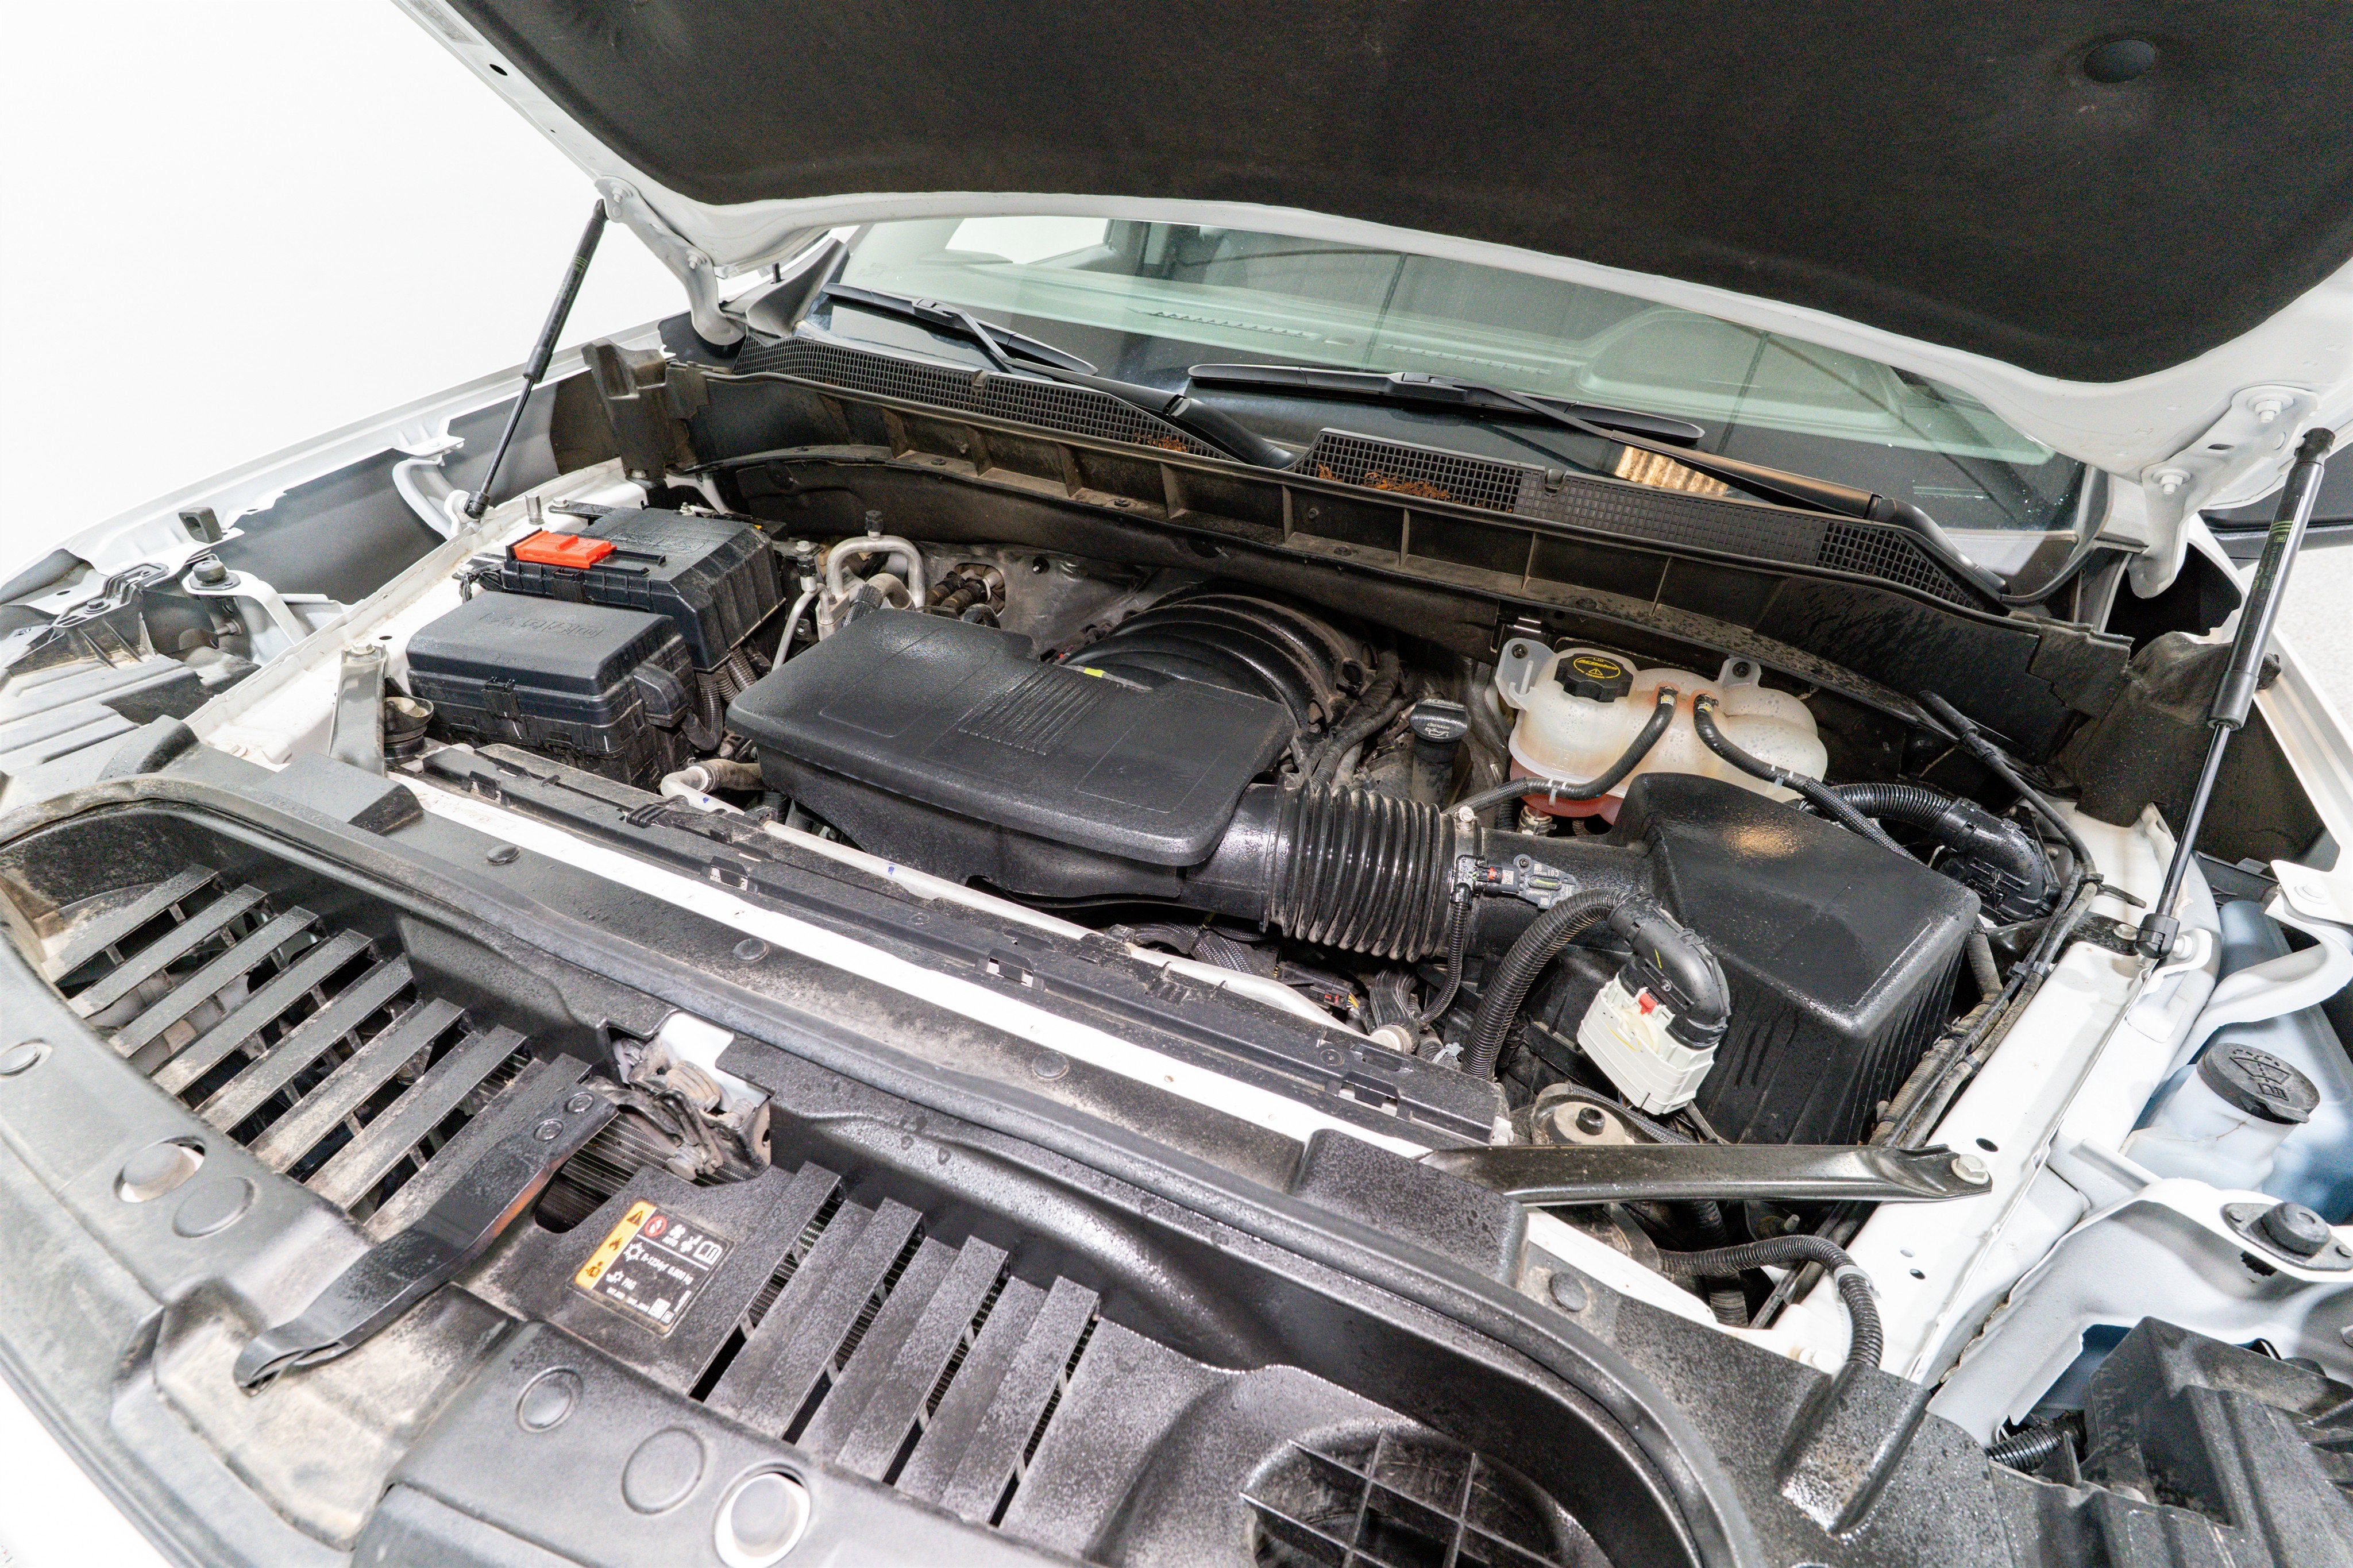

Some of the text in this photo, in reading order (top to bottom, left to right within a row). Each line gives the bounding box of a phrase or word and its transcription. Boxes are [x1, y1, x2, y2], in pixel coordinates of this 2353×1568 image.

[1576, 659, 1618, 670] ACDelco
[1421, 698, 1464, 708] ACDelco
[662, 1235, 678, 1247] AUTO
[641, 1253, 669, 1272] R-1234yf
[682, 1273, 694, 1285] kg
[621, 1277, 637, 1290] PAG
